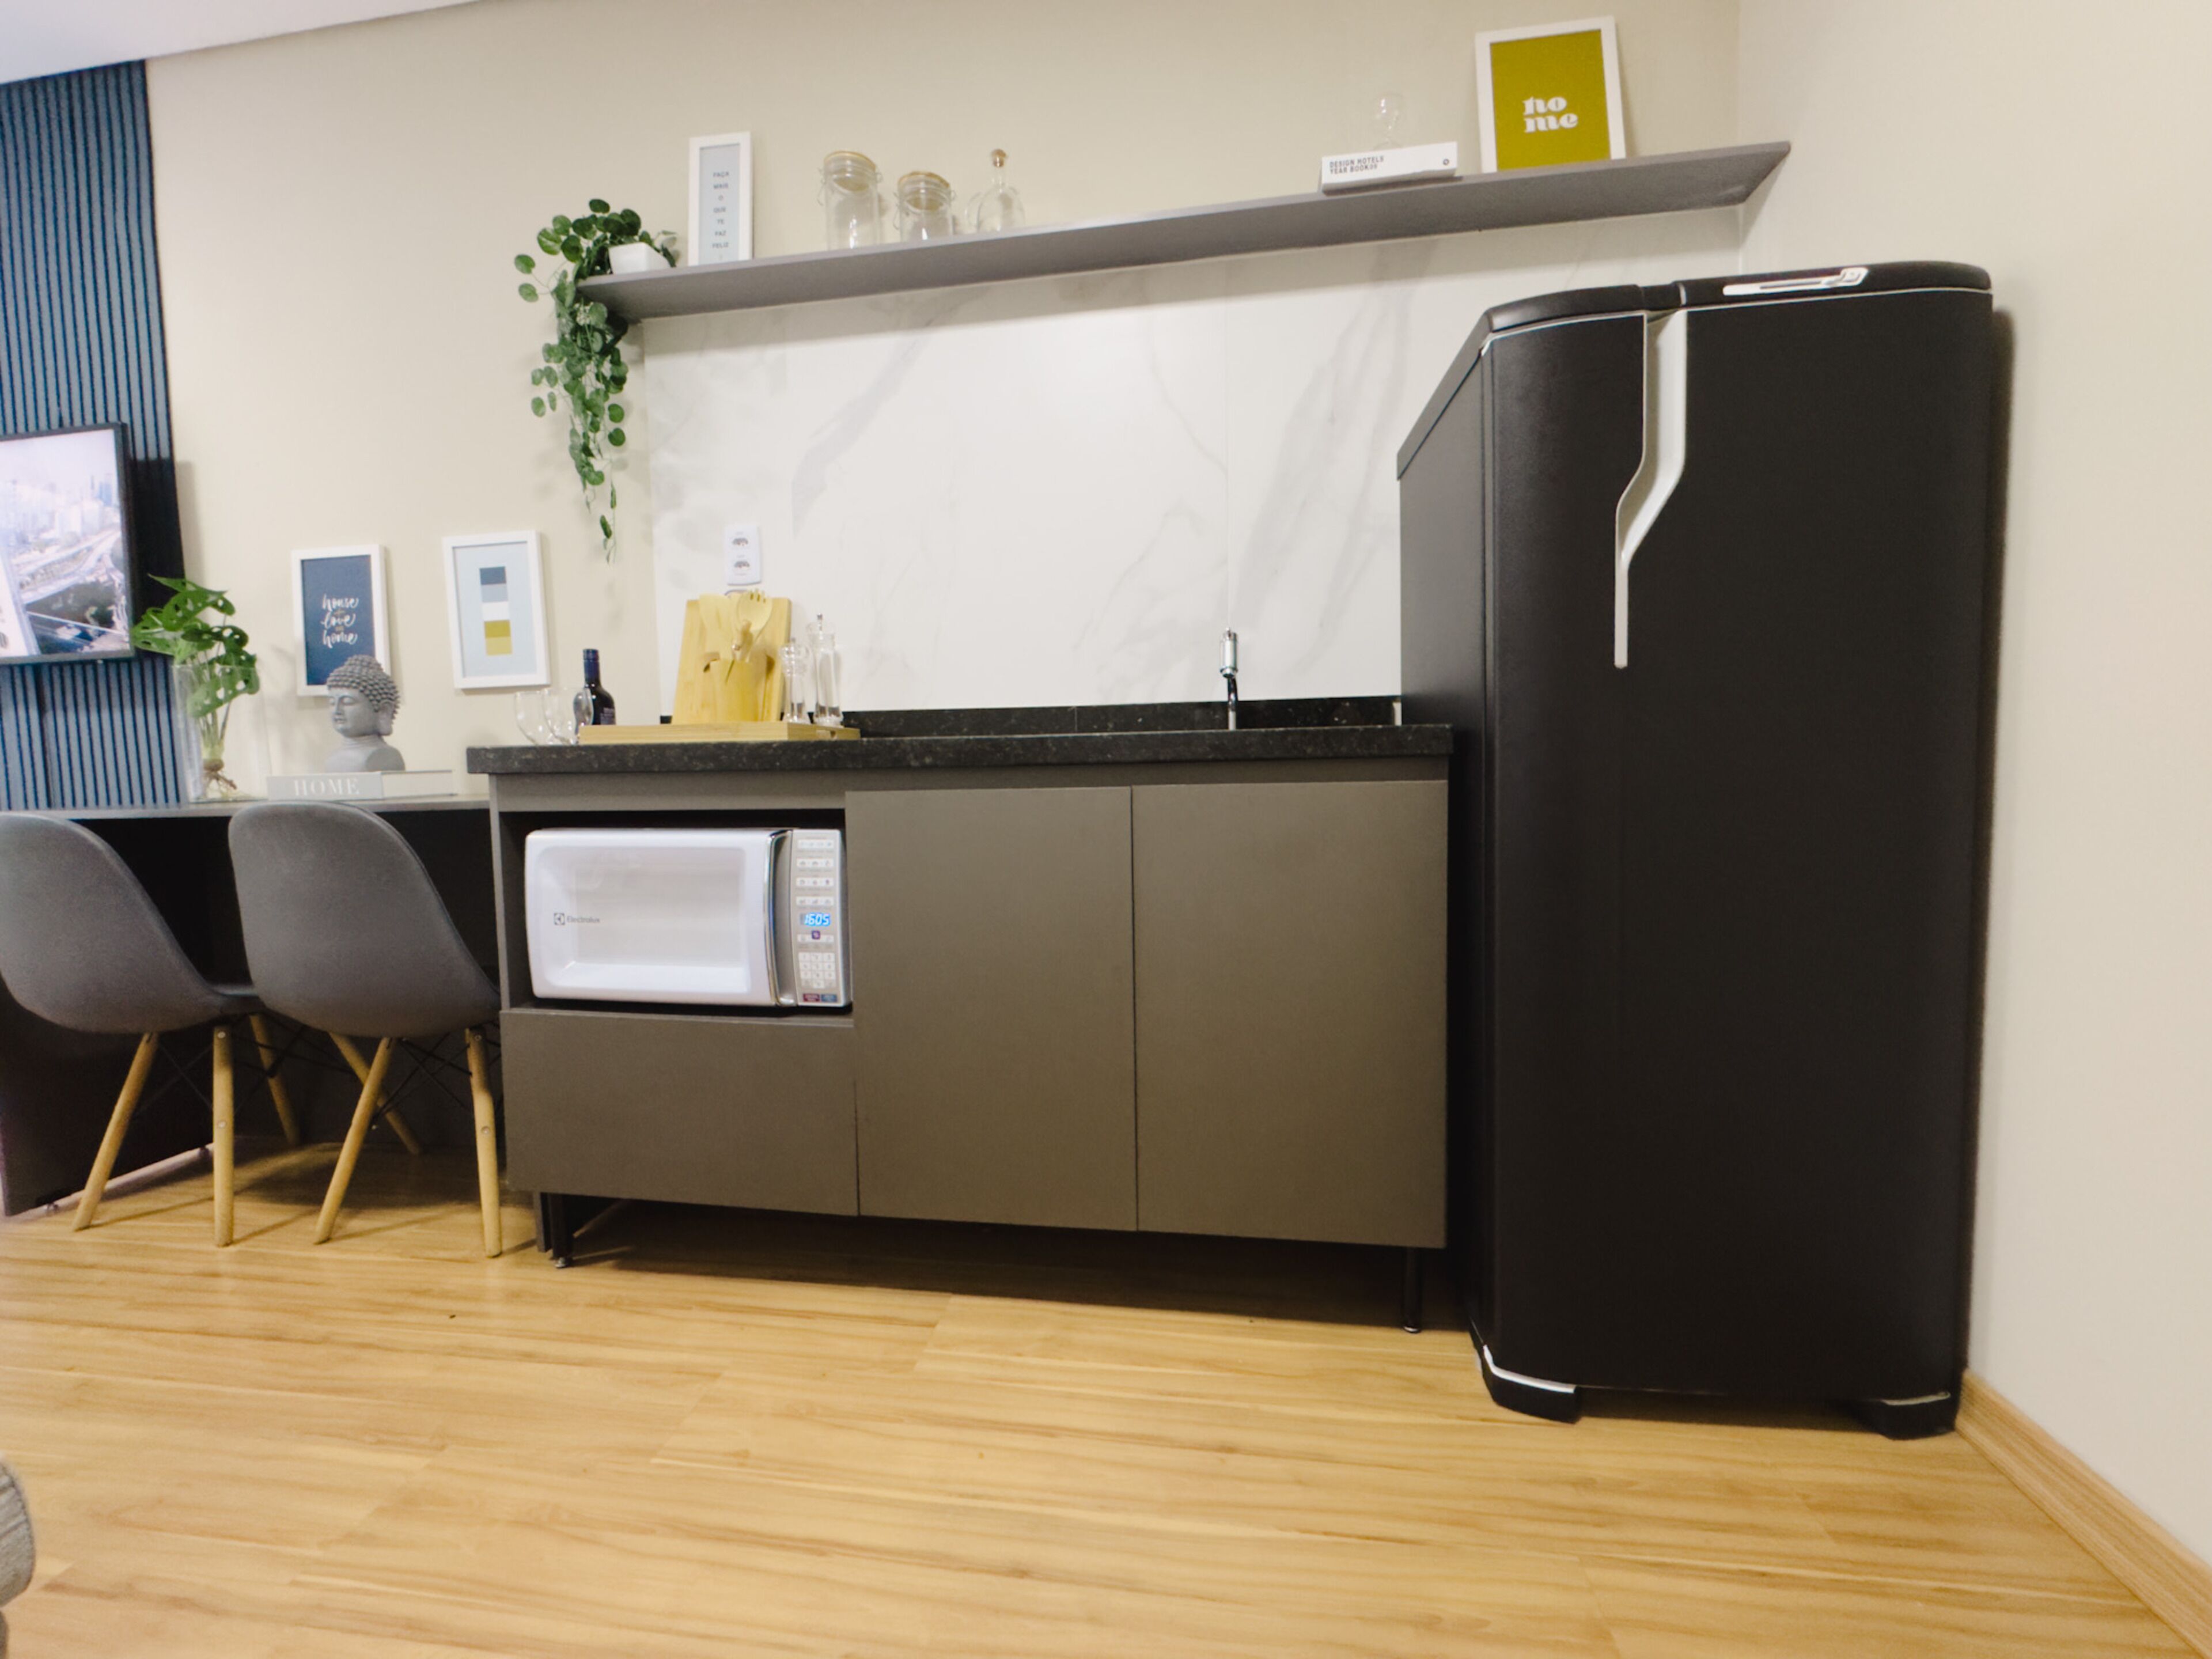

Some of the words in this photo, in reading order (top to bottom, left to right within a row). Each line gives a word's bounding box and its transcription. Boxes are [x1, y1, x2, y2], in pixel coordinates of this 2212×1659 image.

[1522, 96, 1567, 115] no
[1524, 113, 1578, 133] me
[1330, 159, 1355, 168] DESIGN
[1357, 156, 1384, 164] HOTELS
[322, 593, 359, 611] house
[320, 611, 356, 629] love
[322, 630, 358, 649] home
[293, 778, 360, 796] HOME
